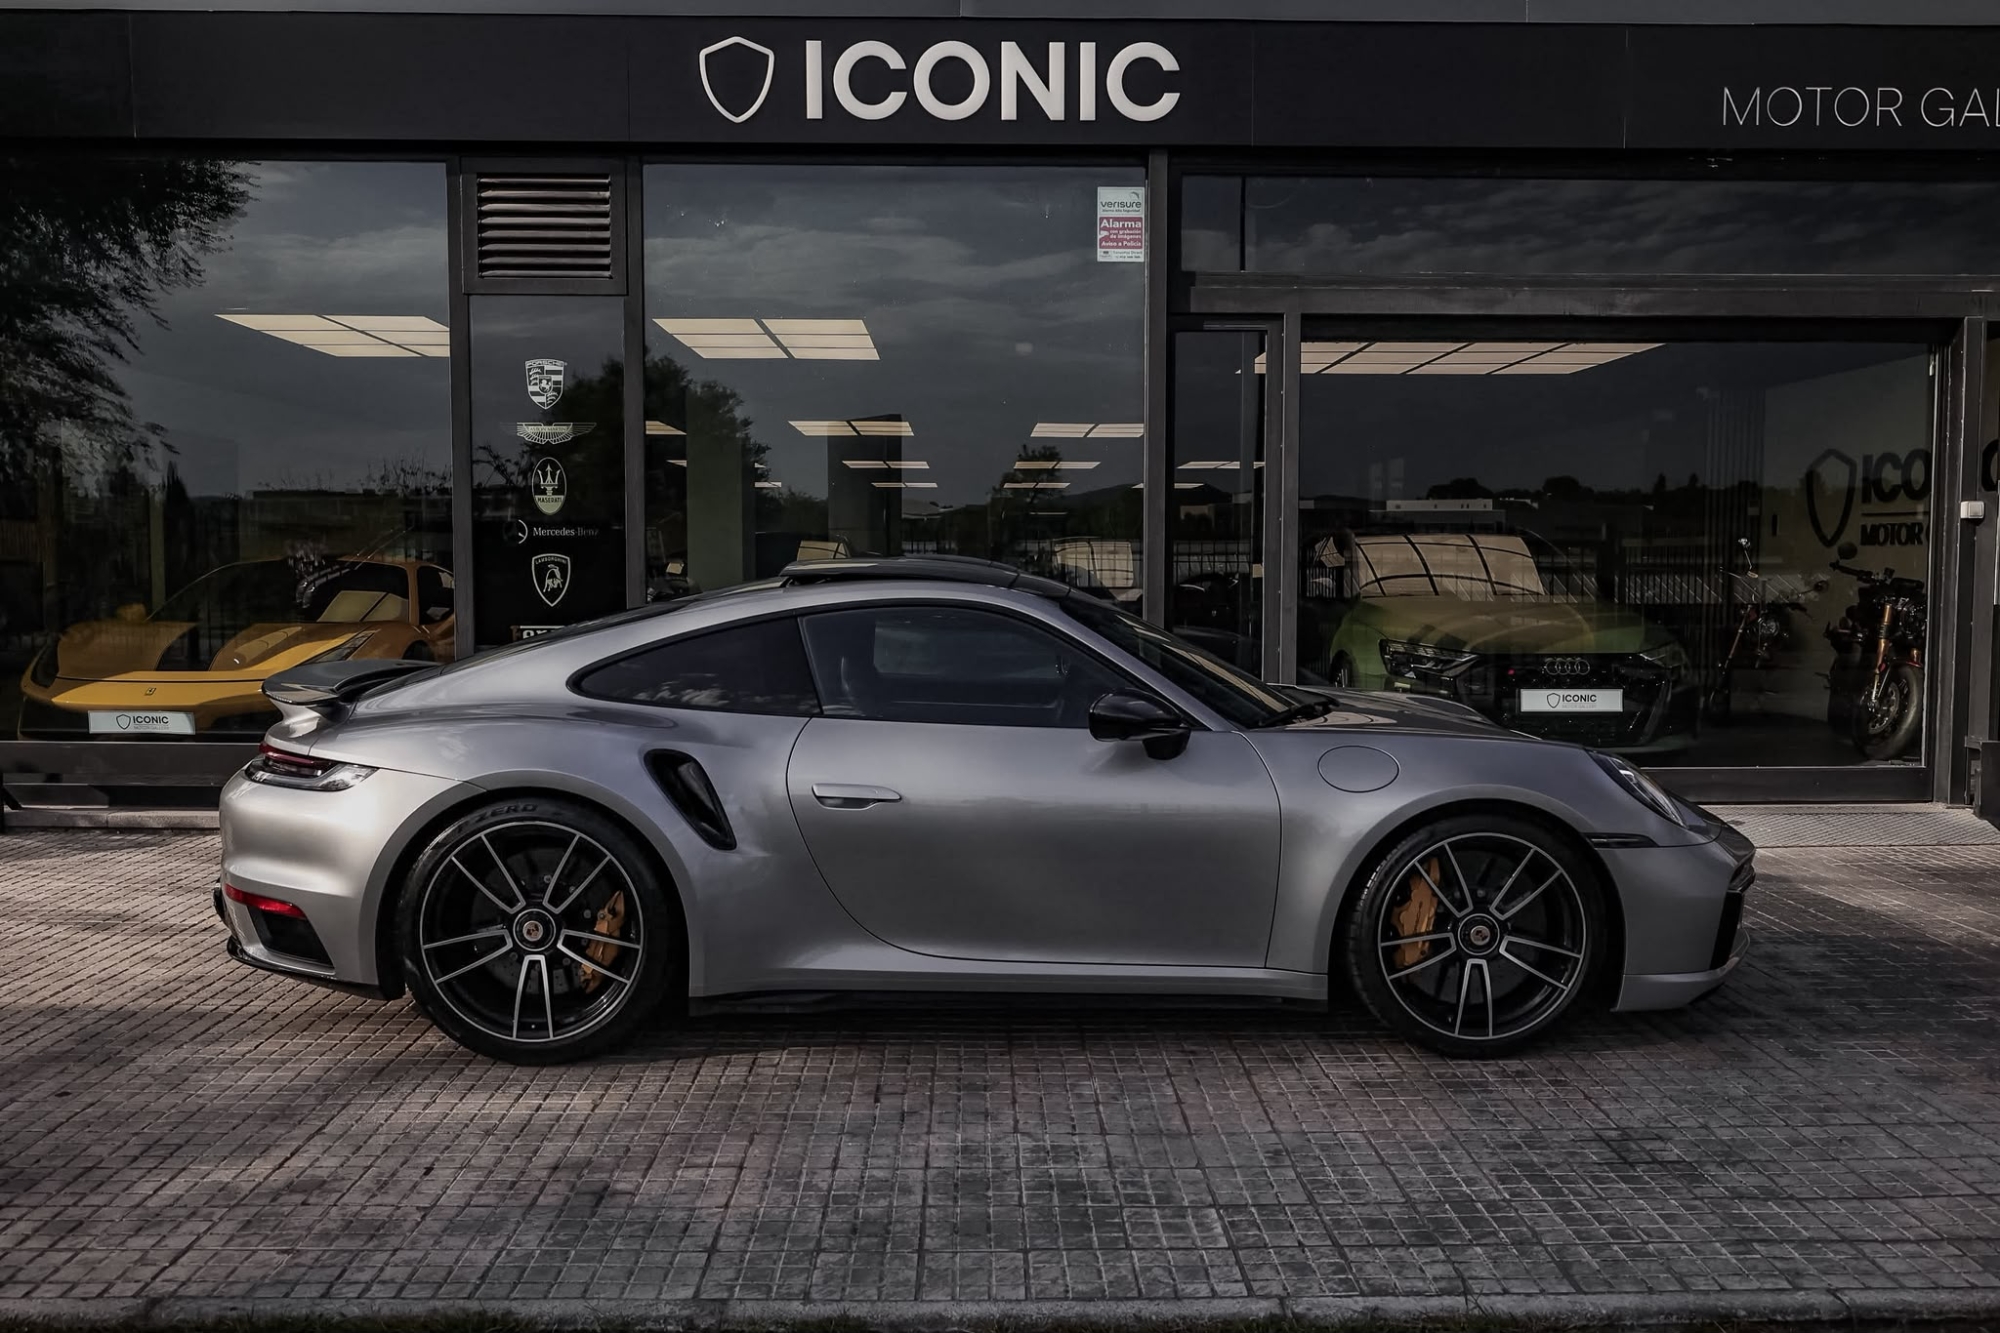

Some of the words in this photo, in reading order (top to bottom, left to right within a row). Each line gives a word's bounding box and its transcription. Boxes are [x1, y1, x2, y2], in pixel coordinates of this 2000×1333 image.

[805, 40, 1181, 122] ICONIC
[1723, 86, 1903, 127] MOTOR
[1101, 219, 1142, 228] Alarma
[532, 526, 600, 537] Mercedes-Benz
[1860, 522, 1924, 546] MOTOR
[1562, 694, 1597, 702] ICONIC
[133, 716, 169, 724] ICONIC
